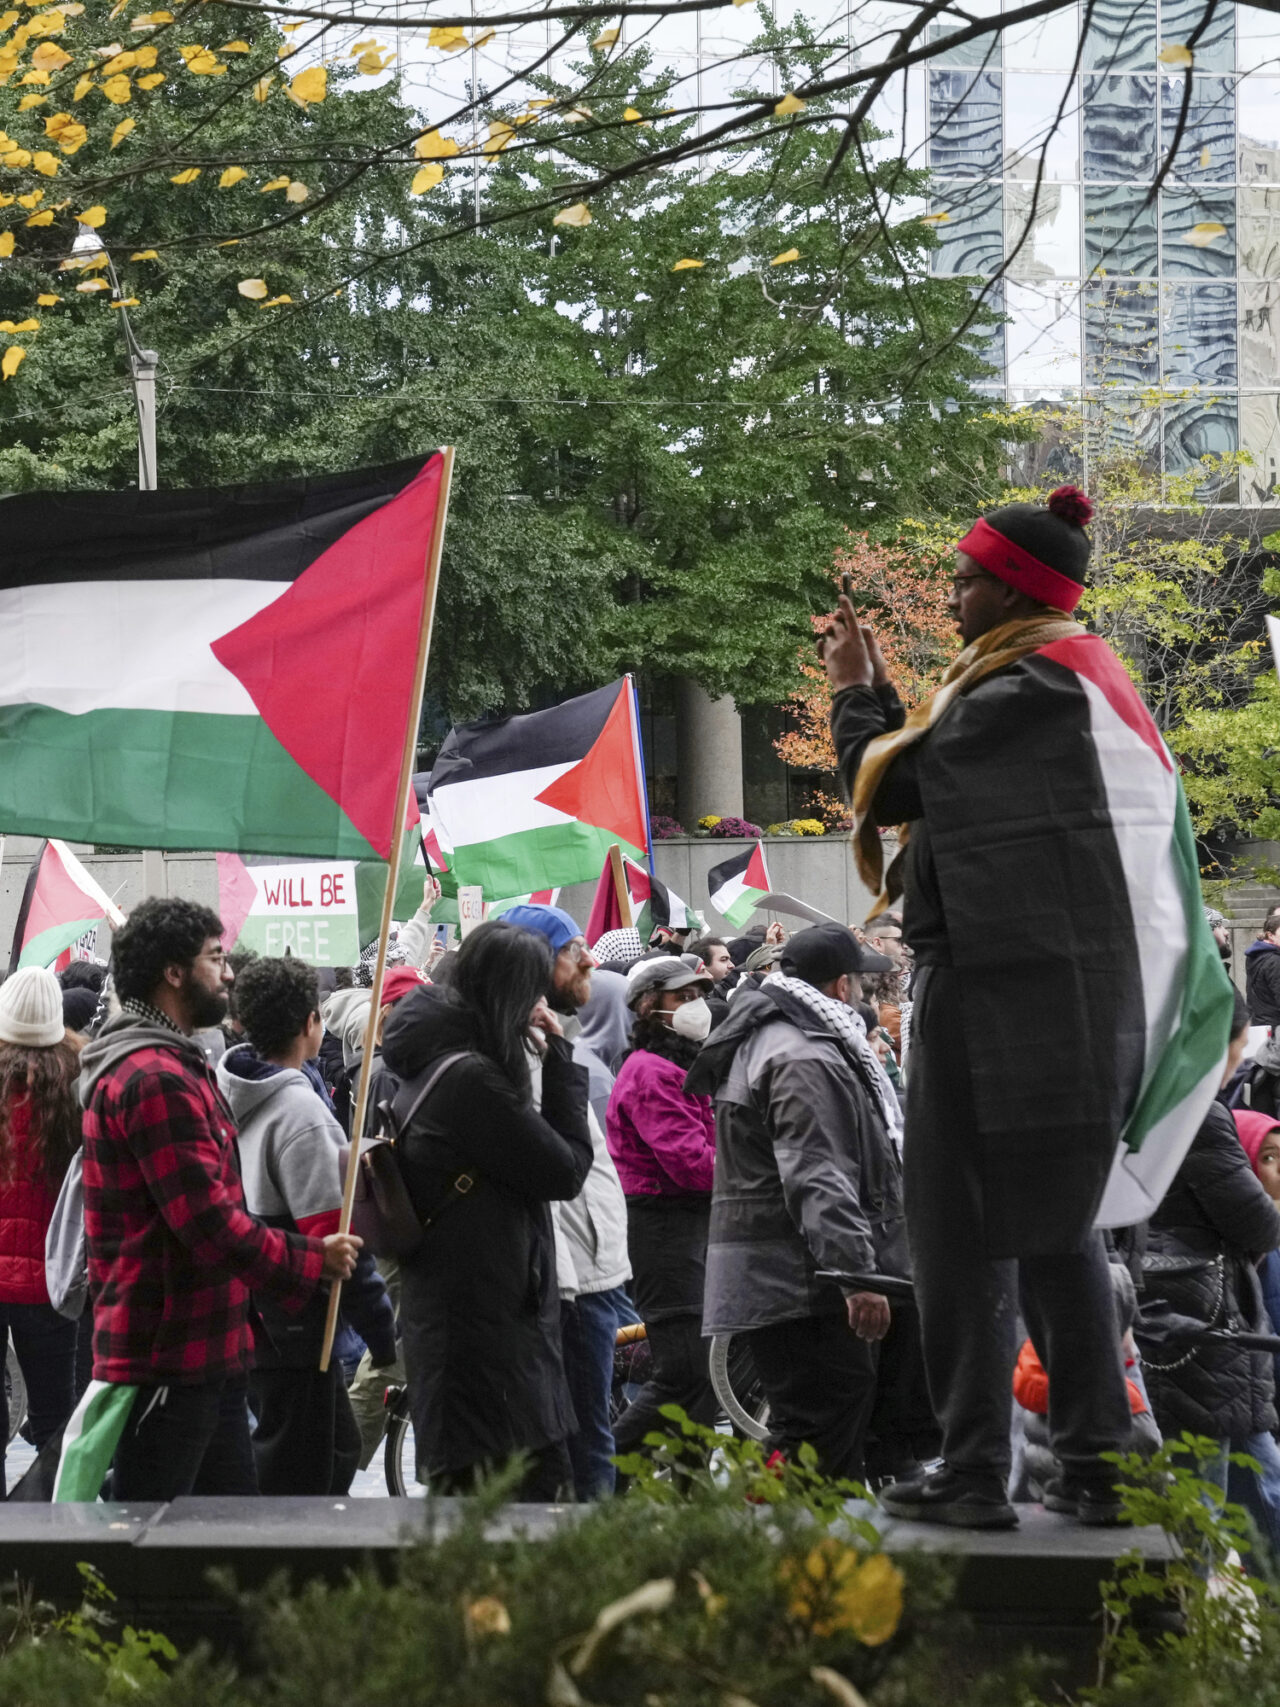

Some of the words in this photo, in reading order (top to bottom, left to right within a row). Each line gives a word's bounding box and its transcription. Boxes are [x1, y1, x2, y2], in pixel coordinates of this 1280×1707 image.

[263, 877, 313, 907] WILL
[320, 873, 346, 907] BE
[265, 920, 331, 961] FREE
